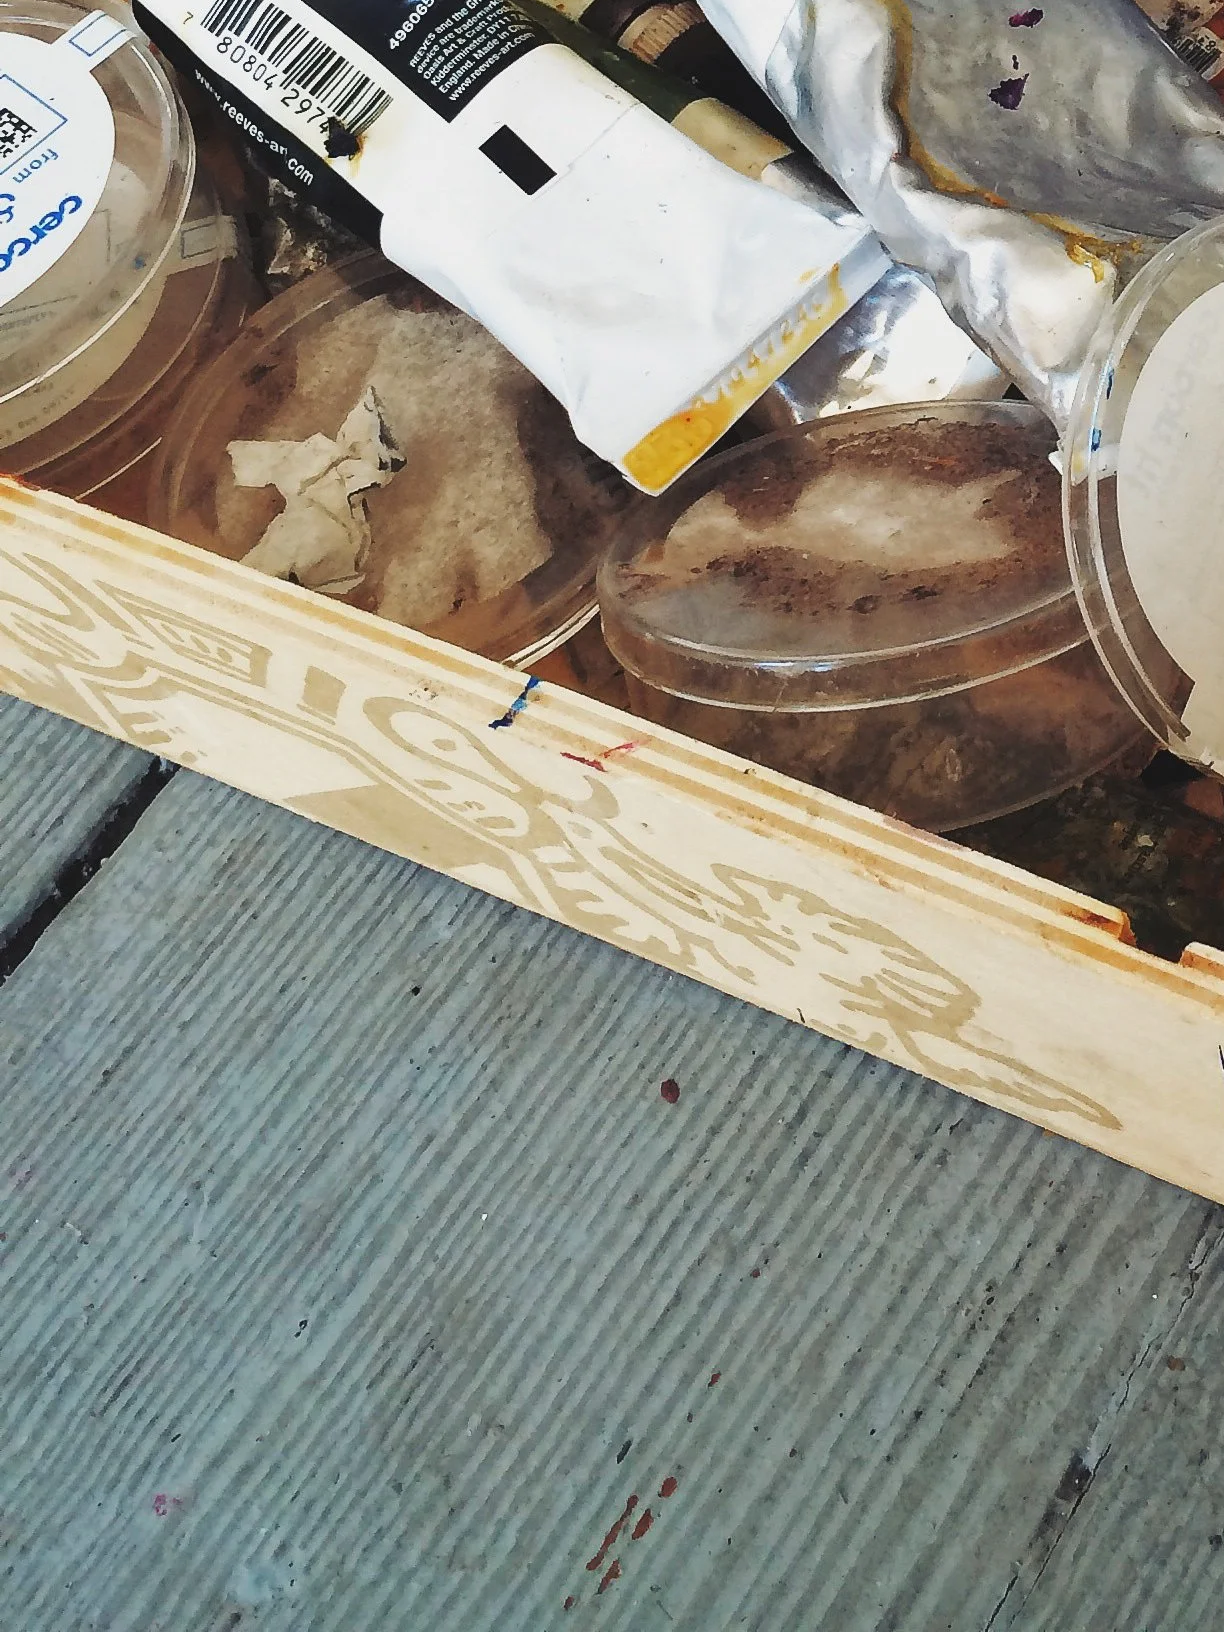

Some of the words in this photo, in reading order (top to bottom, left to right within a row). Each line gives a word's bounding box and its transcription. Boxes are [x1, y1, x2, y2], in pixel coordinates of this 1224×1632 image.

[409, 32, 436, 68] REEVES
[435, 19, 453, 34] and
[452, 8, 470, 21] the
[417, 44, 440, 74] device
[440, 32, 455, 46] are
[442, 43, 458, 57] Art
[458, 37, 466, 46] &
[486, 4, 510, 23] Prod
[473, 38, 500, 60] Made
[499, 30, 510, 40] in
[182, 11, 194, 25] 7
[216, 36, 278, 91] 80804
[280, 88, 331, 134] 2974
[449, 32, 535, 101] www.reeves-art.com
[13, 148, 59, 184] from
